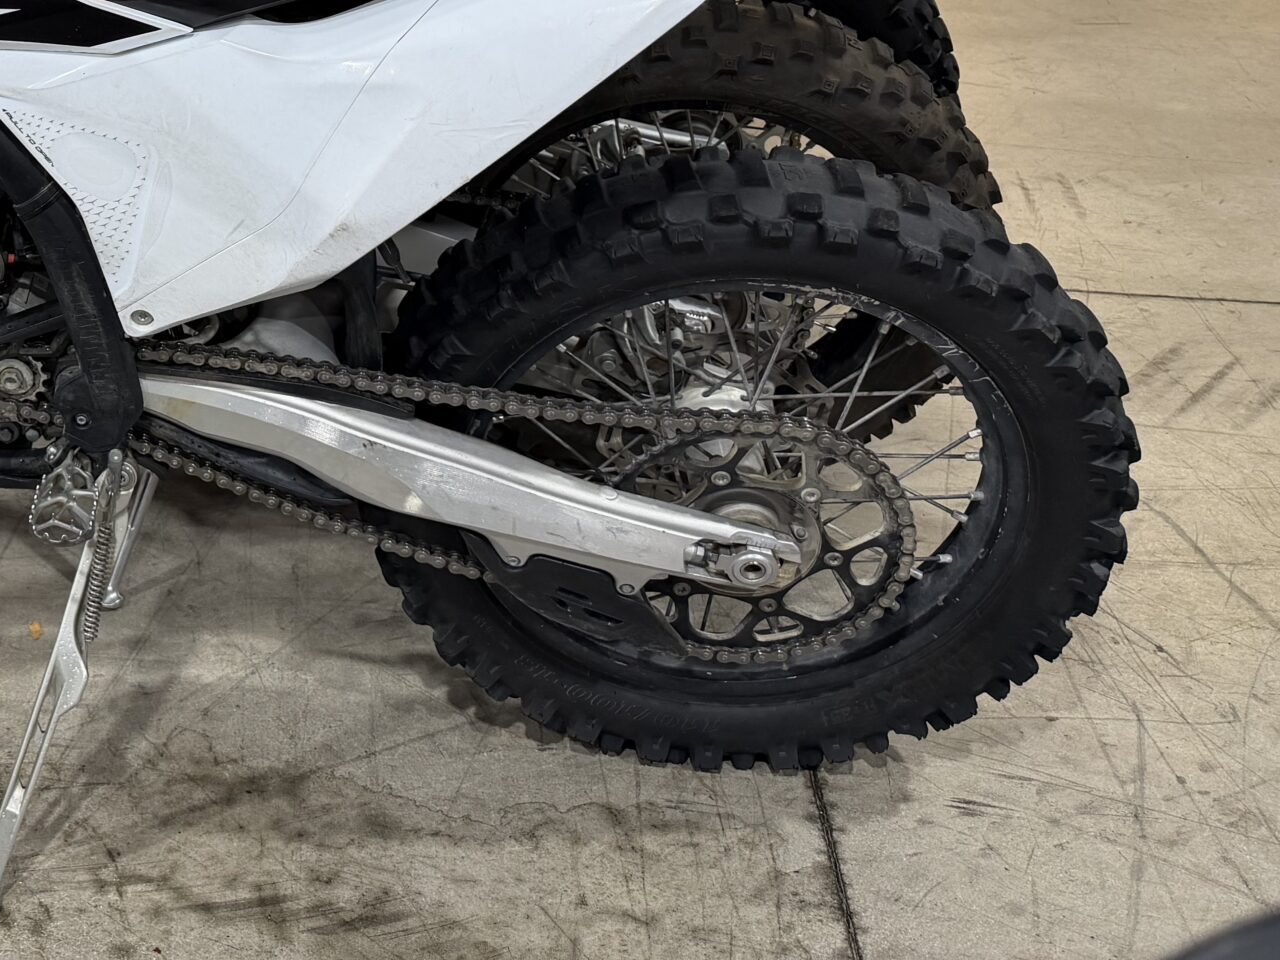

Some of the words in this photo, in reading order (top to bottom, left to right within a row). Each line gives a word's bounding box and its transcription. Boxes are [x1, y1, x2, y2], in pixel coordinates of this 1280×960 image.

[5, 111, 24, 135] PULL
[24, 134, 37, 146] TO
[35, 146, 55, 167] OPEN
